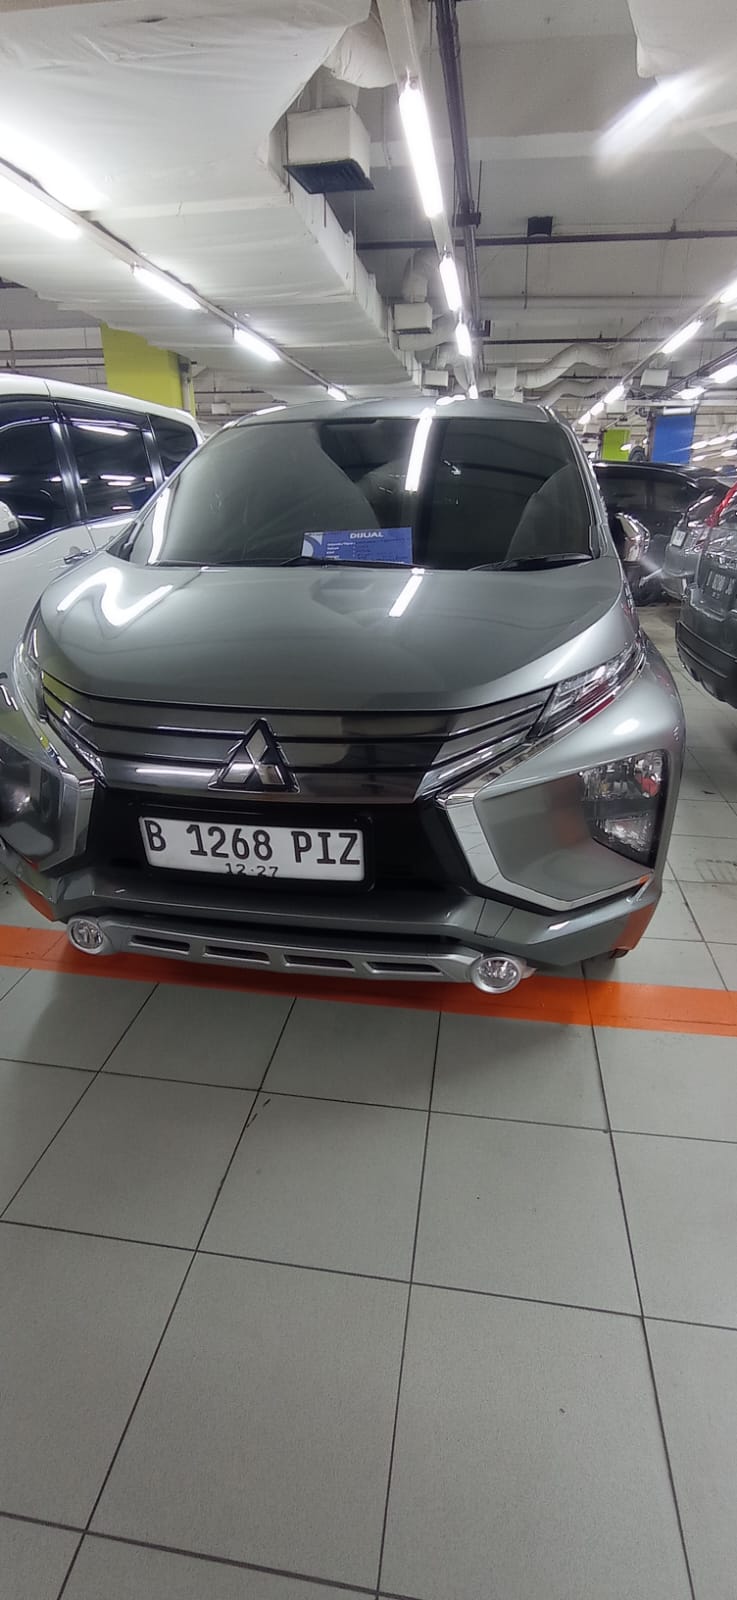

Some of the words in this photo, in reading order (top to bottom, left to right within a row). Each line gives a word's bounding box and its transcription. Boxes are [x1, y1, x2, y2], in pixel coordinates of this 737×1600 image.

[350, 531, 384, 539] DIJUAL
[144, 820, 166, 851] B
[187, 823, 273, 861] 1268
[291, 830, 361, 865] PIZ
